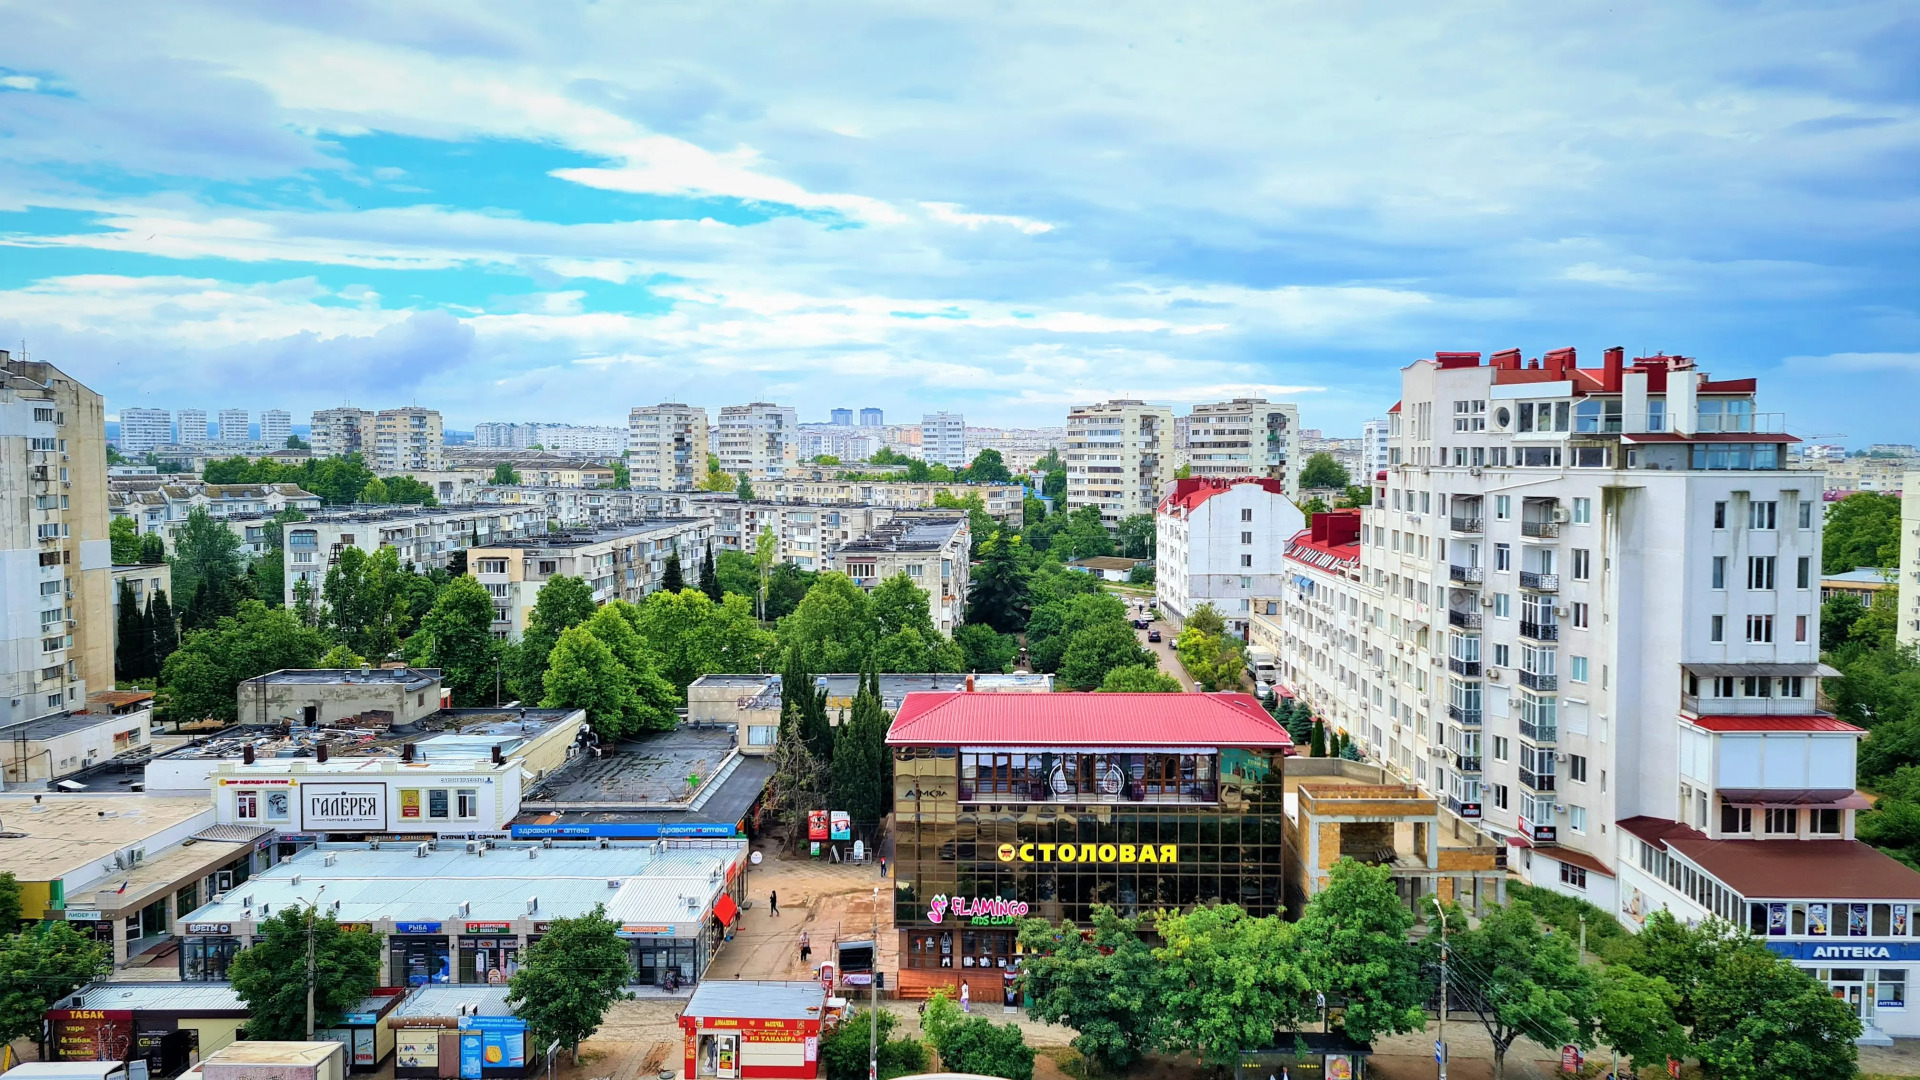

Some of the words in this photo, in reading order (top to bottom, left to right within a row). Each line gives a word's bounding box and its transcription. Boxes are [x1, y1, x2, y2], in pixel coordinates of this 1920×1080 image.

[311, 797, 376, 816] ГАЛЕРЕЯ
[518, 826, 558, 835] здравсити
[657, 826, 696, 835] здравсити
[702, 826, 728, 834] аптека
[1019, 843, 1178, 863] СТОЛОВАЯ
[971, 915, 990, 926] KIDS
[990, 915, 1014, 925] CLUB
[189, 924, 218, 933] ЦВЕТЫ
[1812, 946, 1891, 958] АПТЕКА
[69, 1010, 105, 1019] ТАБАК
[66, 1025, 85, 1033] vape
